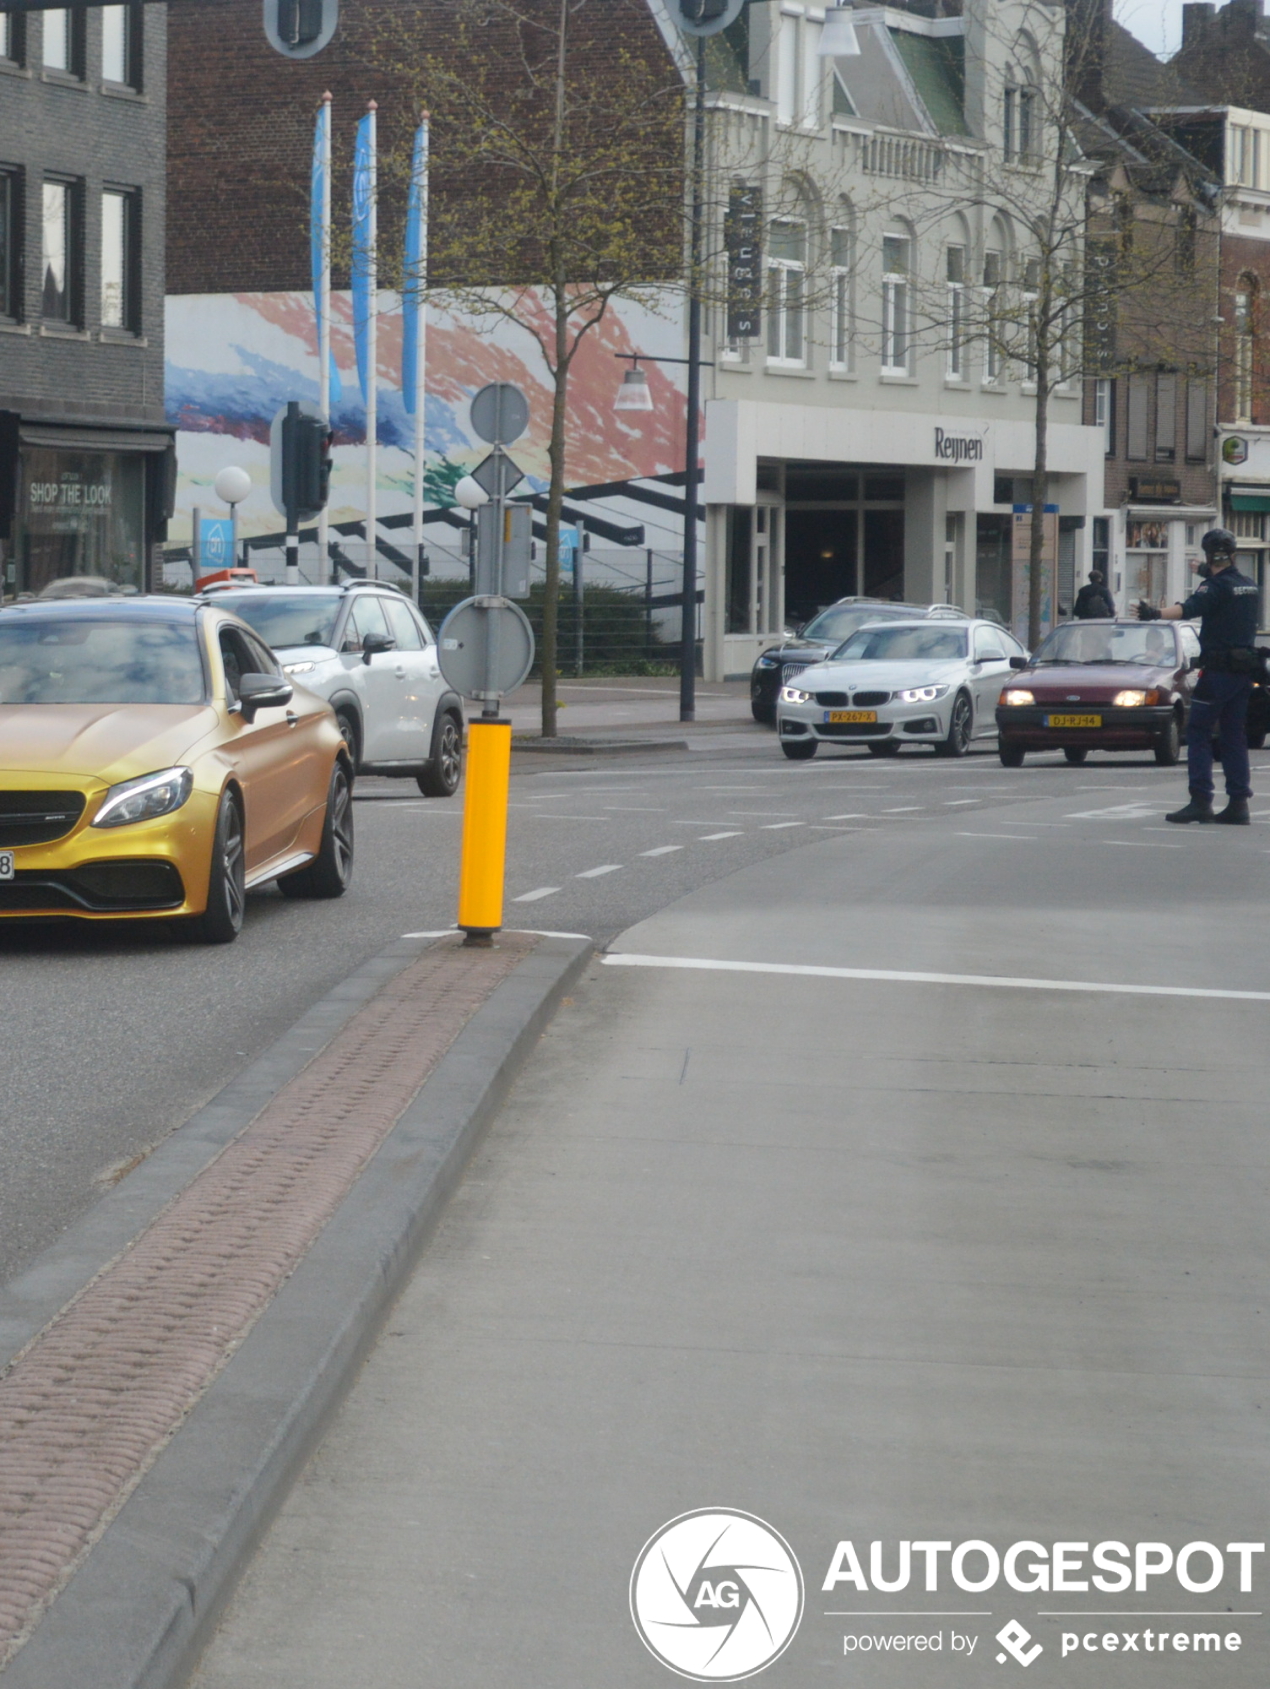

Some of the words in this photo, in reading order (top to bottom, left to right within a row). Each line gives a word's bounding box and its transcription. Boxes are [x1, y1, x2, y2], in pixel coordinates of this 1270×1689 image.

[30, 482, 58, 503] SHOP
[60, 484, 82, 504] THE
[84, 485, 112, 505] LOOK
[1053, 715, 1095, 726] DJ-RJ-14
